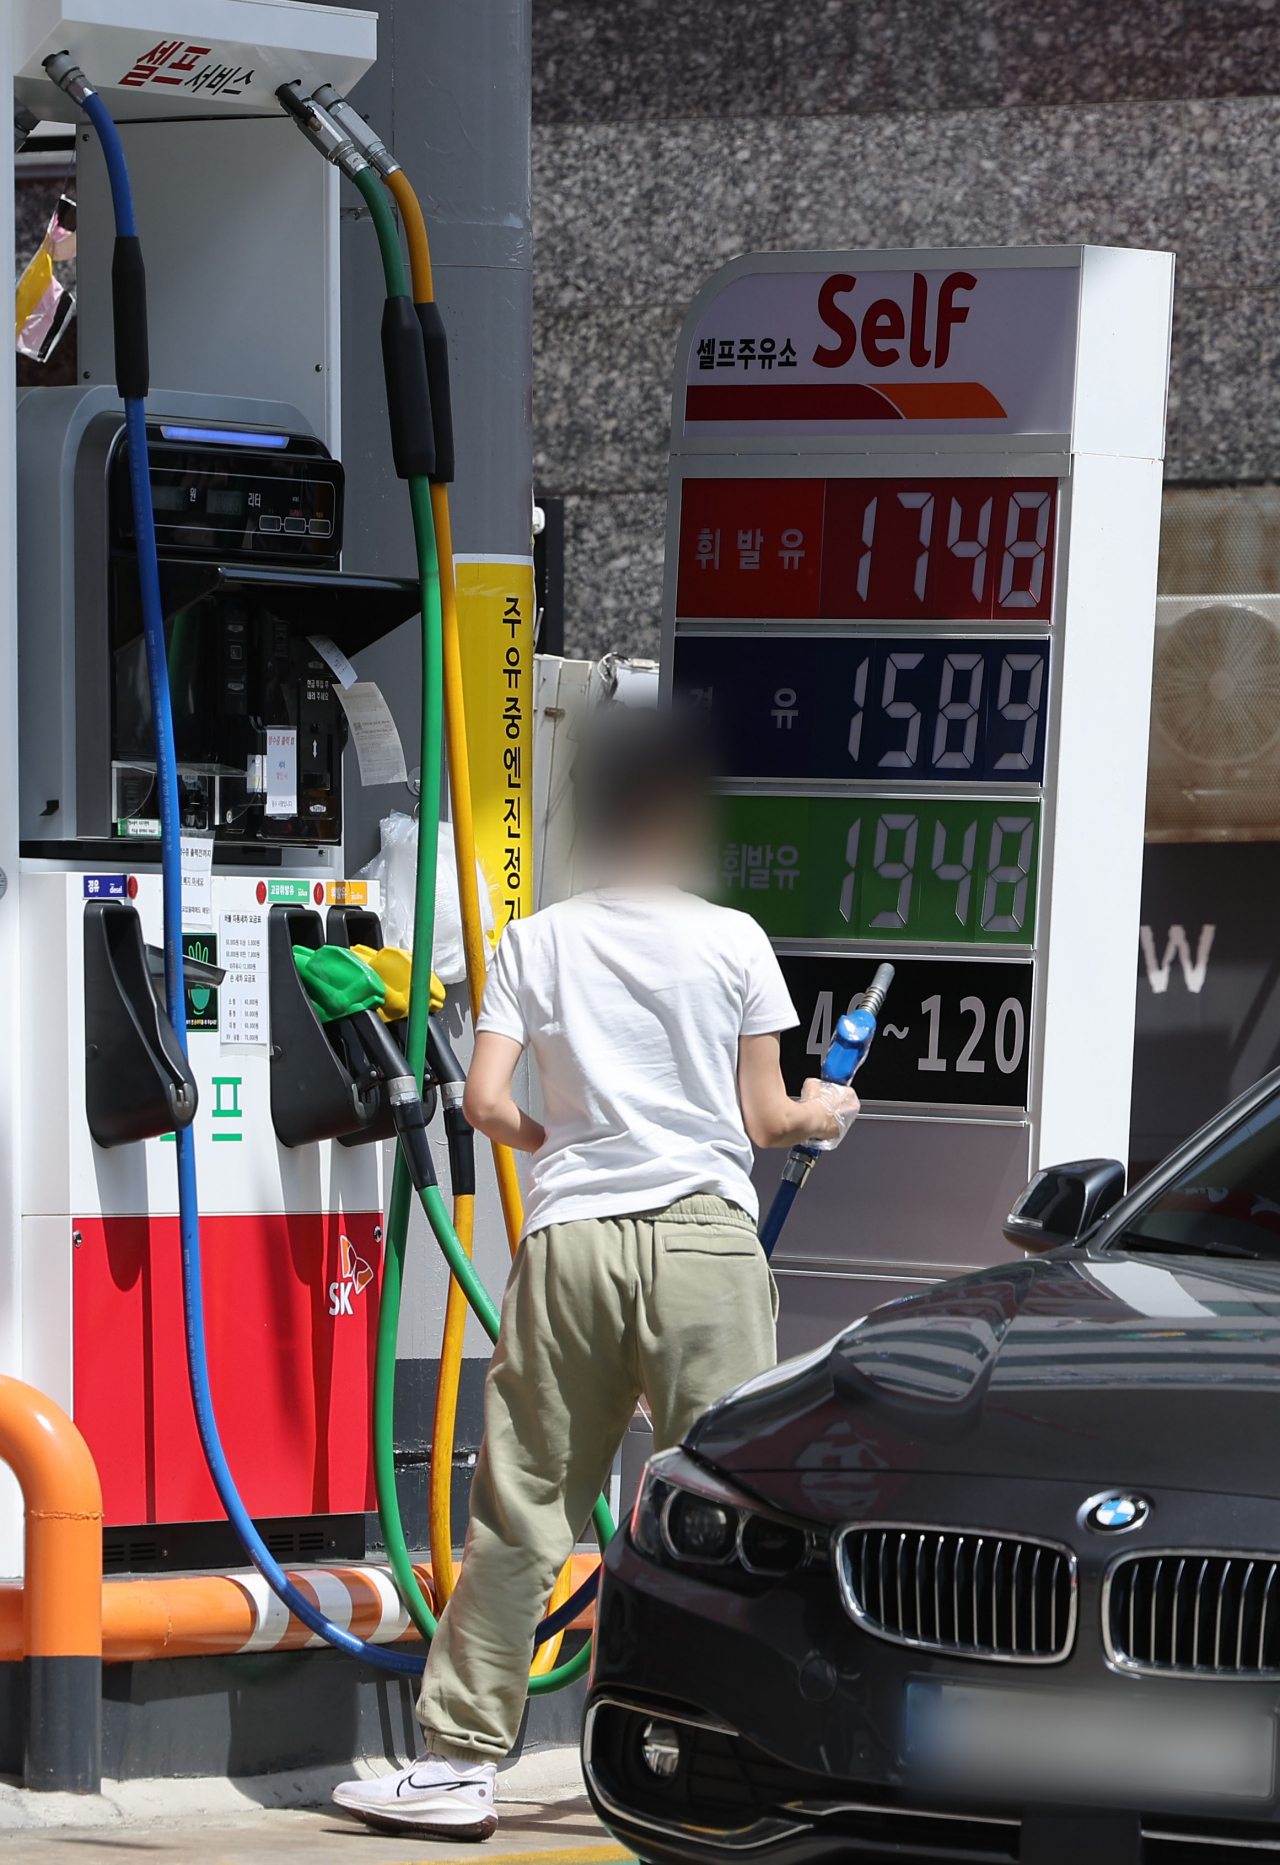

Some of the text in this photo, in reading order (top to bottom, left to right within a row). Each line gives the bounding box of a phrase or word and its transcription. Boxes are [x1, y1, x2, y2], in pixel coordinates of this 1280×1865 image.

[118, 41, 255, 95] 셀프 서비스
[697, 337, 797, 370] 셀프주유소
[812, 272, 978, 369] Self
[248, 493, 261, 507] 리터
[695, 491, 1051, 608] 휘발유 1748
[848, 653, 1044, 770] 1589
[88, 879, 100, 893] 경유
[839, 814, 1034, 932] 1948
[806, 990, 1025, 1074] 4~120
[329, 1282, 354, 1316] SK
